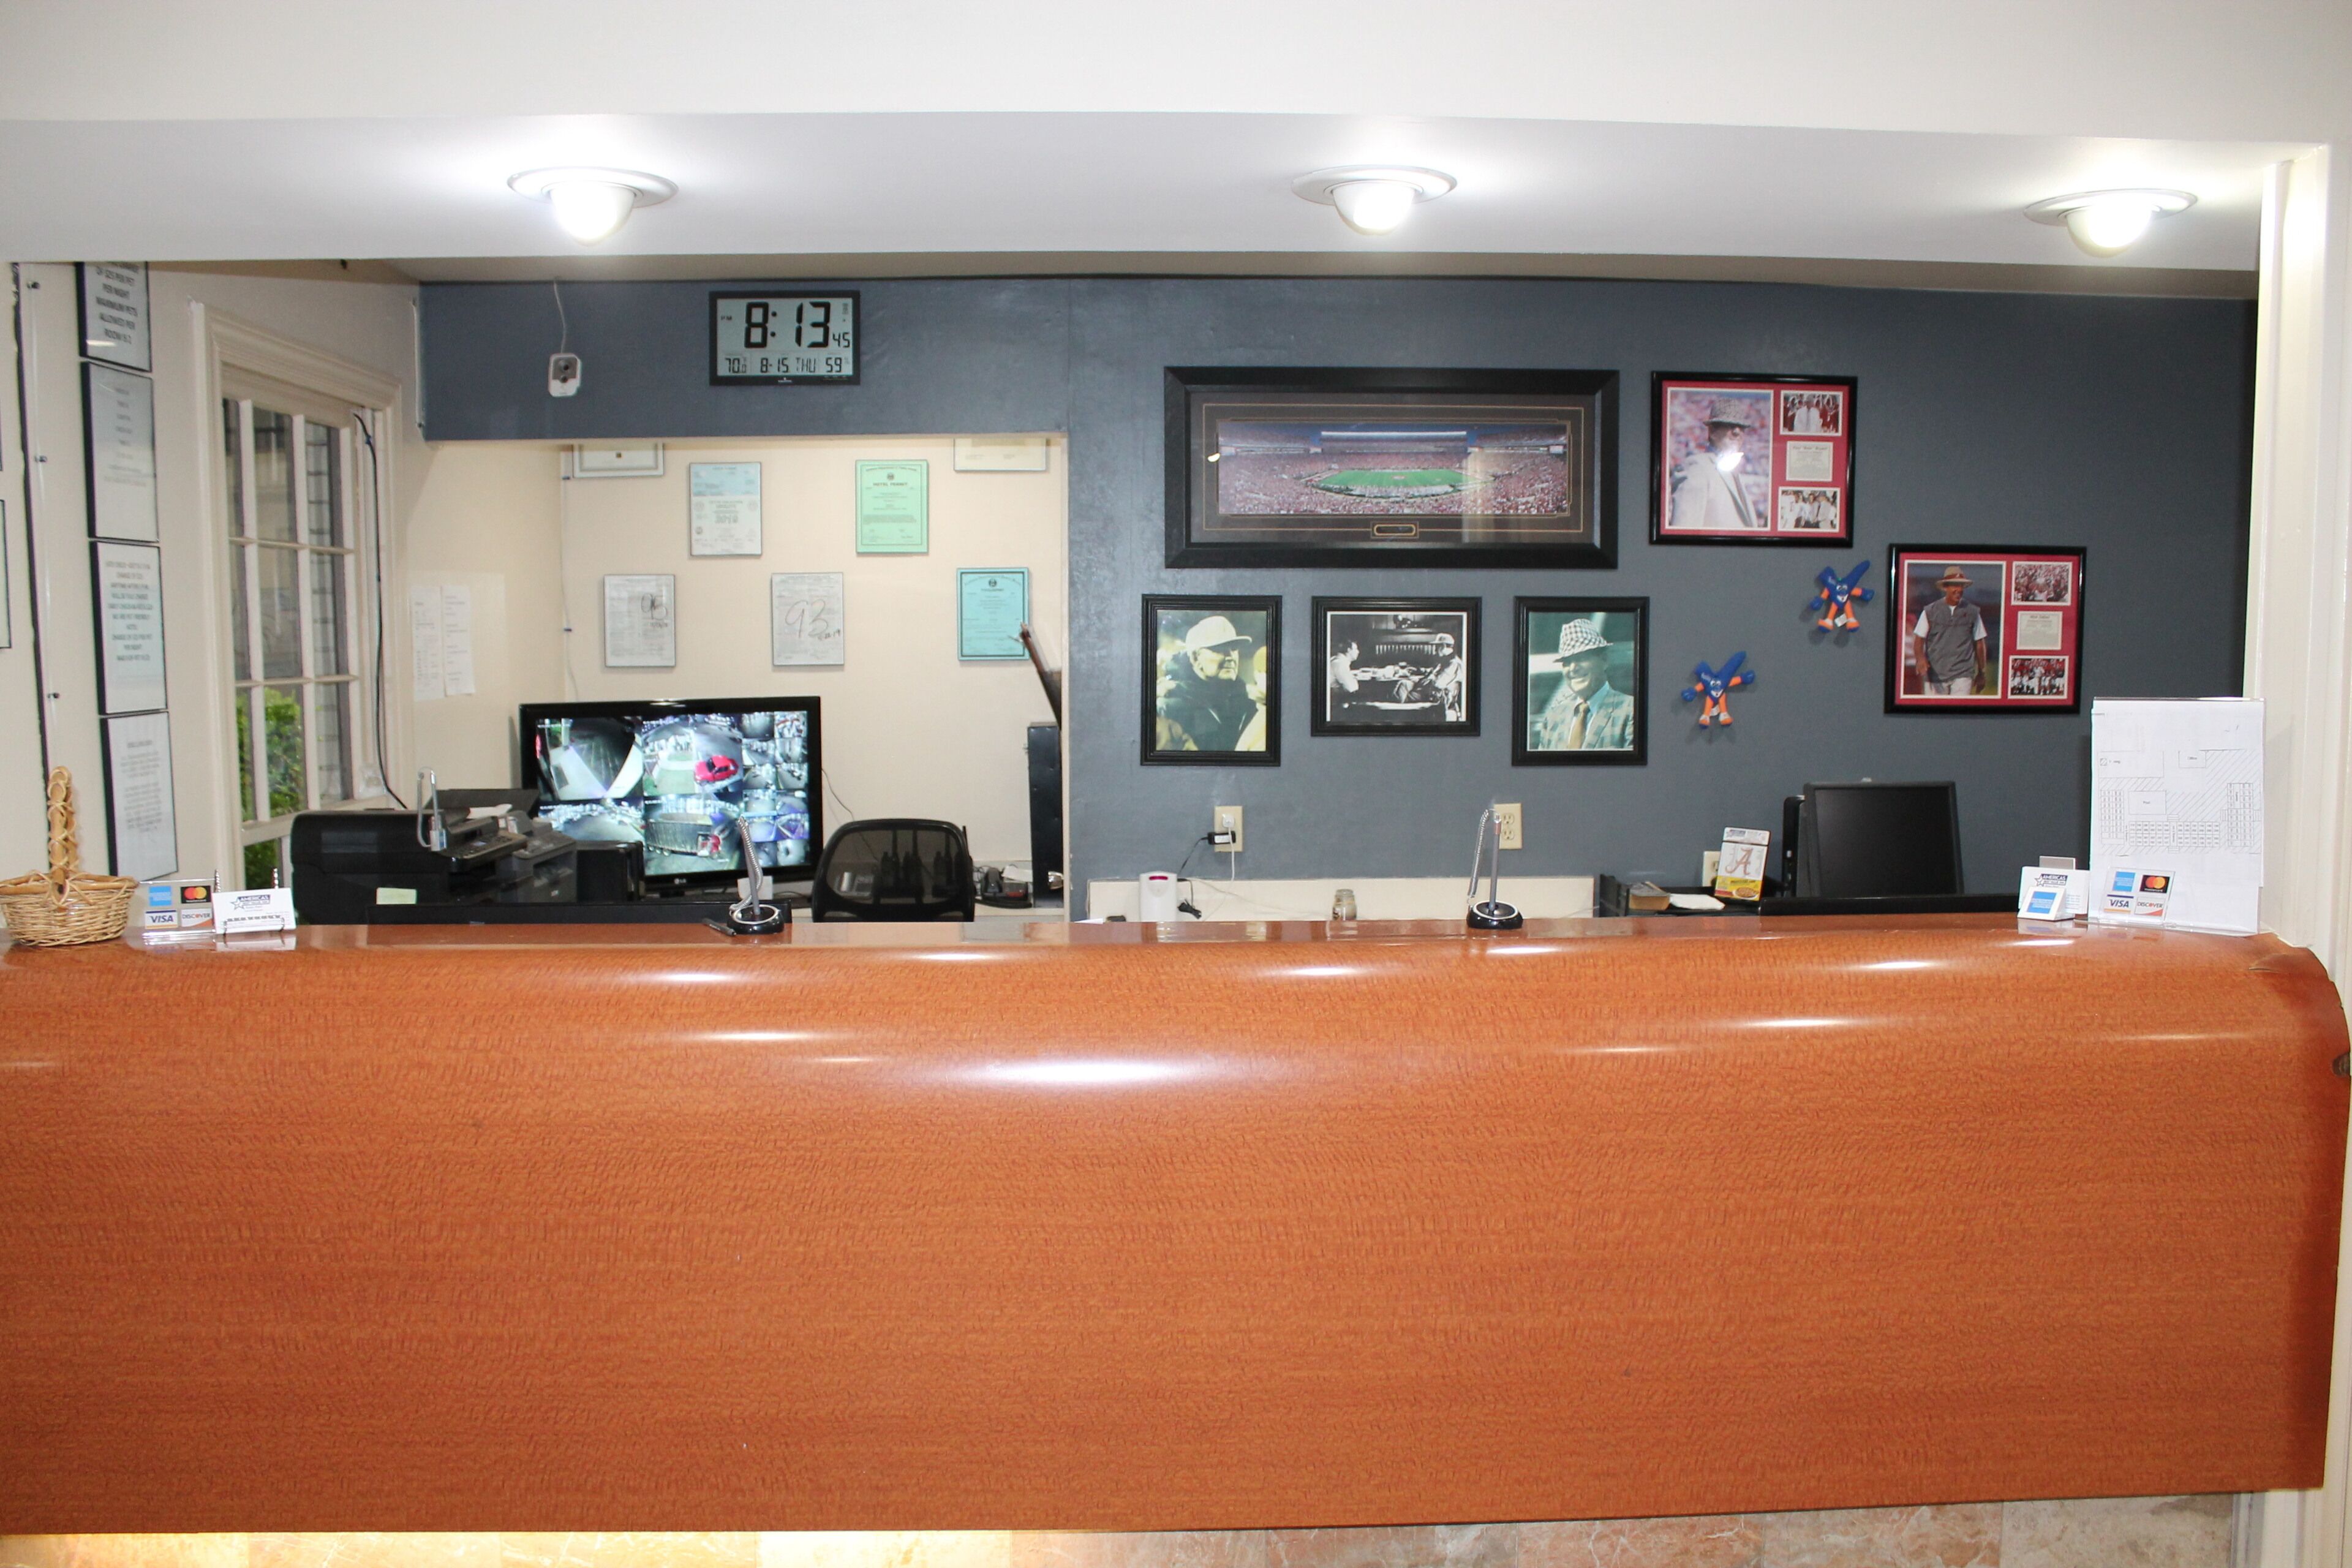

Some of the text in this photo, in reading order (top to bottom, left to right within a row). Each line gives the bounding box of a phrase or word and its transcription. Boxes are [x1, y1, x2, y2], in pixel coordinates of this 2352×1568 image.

[744, 301, 831, 349] 8:13
[832, 332, 851, 348] 45
[796, 357, 816, 373] THU
[825, 357, 842, 373] 59
[2109, 899, 2130, 908] VISA
[149, 914, 174, 924] VISA
